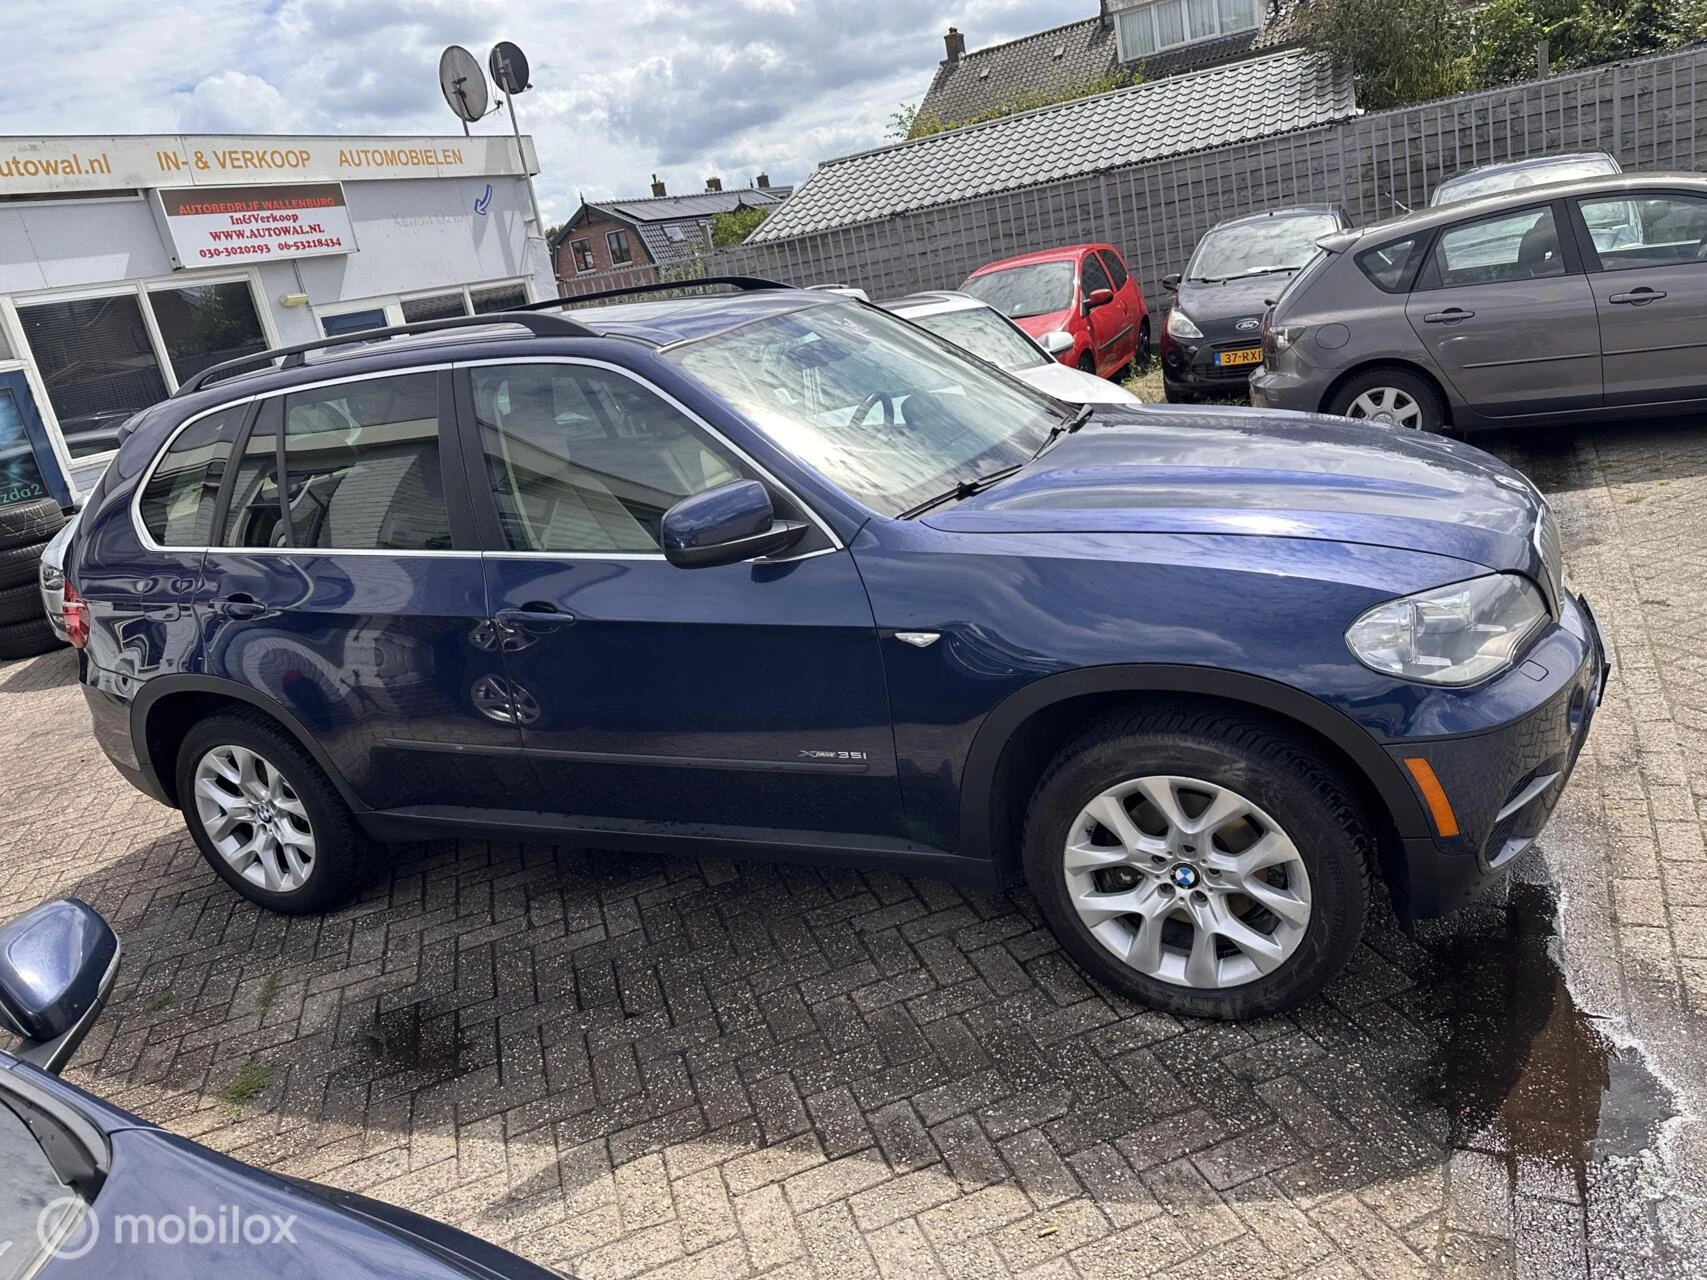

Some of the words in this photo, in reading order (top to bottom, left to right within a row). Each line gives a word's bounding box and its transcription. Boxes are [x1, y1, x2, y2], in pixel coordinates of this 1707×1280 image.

[0, 153, 112, 177] utowal.nl
[157, 151, 188, 171] IN-
[195, 150, 210, 170] &
[213, 150, 311, 169] VERKOOP
[339, 149, 464, 167] AUTOMOBIELEN
[179, 201, 259, 215] AUTOBEDRIJF
[261, 197, 335, 210] WALLENBURG
[230, 212, 299, 226] In&Verkoop
[209, 223, 325, 242] WWW.AUTOWAL.NL
[199, 243, 271, 258] 030-3020293
[277, 237, 342, 251] 06-53218434
